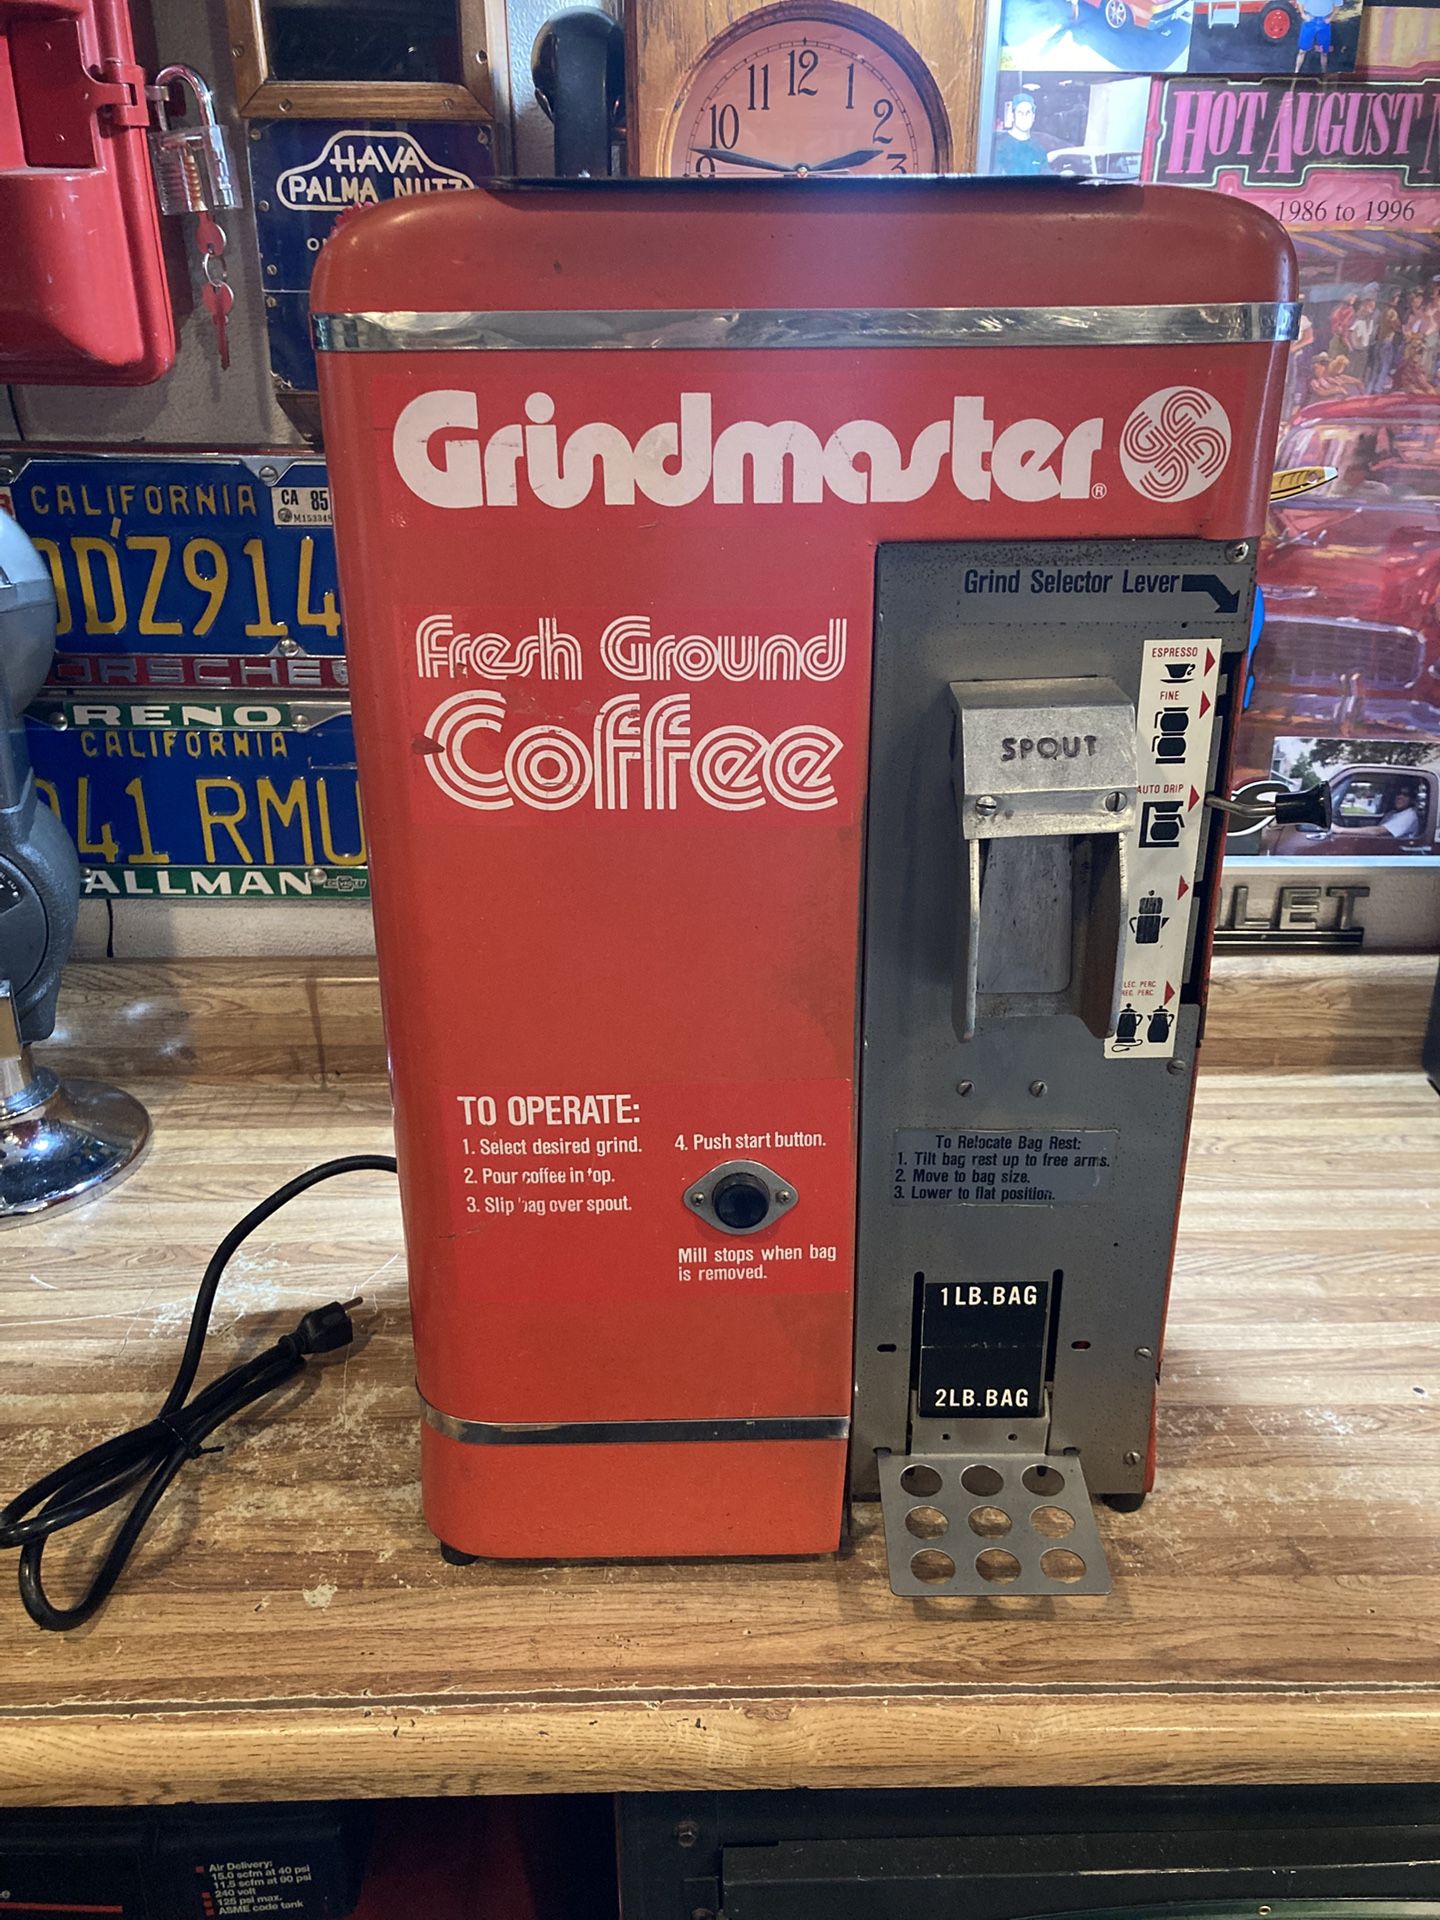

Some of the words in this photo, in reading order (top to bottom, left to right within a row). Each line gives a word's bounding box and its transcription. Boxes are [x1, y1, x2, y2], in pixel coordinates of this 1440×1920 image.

[788, 49, 818, 96] 12
[748, 64, 770, 110] 11
[845, 63, 854, 109] 1
[709, 104, 739, 149] 10
[872, 99, 894, 144] 2
[1165, 90, 1269, 173] HOT
[1257, 91, 1423, 173] AUGUST
[330, 145, 424, 173] HAVA
[288, 176, 379, 203] PALMA
[1278, 200, 1327, 222] 1986
[1335, 203, 1355, 221] to
[1365, 200, 1415, 222] 1996
[31, 485, 257, 516] CALIFORNIA
[281, 489, 299, 505] CA
[310, 490, 328, 511] 85
[964, 569, 1020, 593] Grind
[1030, 569, 1113, 593] Selector
[1122, 569, 1180, 593] Lever
[415, 614, 582, 680] Fresh
[600, 615, 847, 682] Ground
[1152, 647, 1198, 657] ESPRESSO
[56, 659, 321, 685] ORSCHE
[1160, 690, 1180, 701] FINE
[72, 706, 282, 726] RENO
[80, 731, 288, 758] CALIFORNIA
[423, 689, 844, 811] Coffee
[1000, 735, 1097, 762] SPOUT
[1137, 784, 1160, 794] AUTO
[1163, 784, 1184, 794] DRIP
[196, 776, 367, 865] RMU
[84, 870, 313, 896] ALLMAN
[1217, 885, 1370, 930] LET
[457, 1095, 497, 1126] TO
[507, 1094, 640, 1126] OPERATE:
[463, 1139, 475, 1155] 1.
[480, 1138, 527, 1155] Select
[533, 1137, 590, 1155] desired
[596, 1136, 642, 1157] grind.
[674, 1134, 688, 1151] 4.
[693, 1133, 732, 1150] Push
[736, 1133, 771, 1149] start
[775, 1132, 826, 1148] button.
[936, 1135, 951, 1149] To
[958, 1135, 1012, 1149] Relocate
[1018, 1136, 1043, 1152] Bag
[1050, 1136, 1081, 1150] Rest:
[898, 1152, 907, 1166] 1.
[915, 1152, 937, 1166] Tilt
[942, 1152, 966, 1168] bag
[972, 1153, 997, 1167] rest
[1003, 1155, 1019, 1168] up
[1025, 1153, 1037, 1167] to
[1043, 1153, 1068, 1167] free
[1074, 1155, 1110, 1167] arms.
[464, 1168, 478, 1184] 2.
[482, 1168, 518, 1184] Pour
[522, 1168, 566, 1184] coffee
[570, 1167, 584, 1183] in
[895, 1169, 906, 1182] 2.
[913, 1169, 949, 1183] Move
[955, 1170, 966, 1183] to
[972, 1170, 996, 1186] bag
[1001, 1171, 1030, 1183] size.
[894, 1186, 904, 1199] 3.
[911, 1186, 952, 1199] Lower
[958, 1186, 969, 1199] to
[975, 1186, 996, 1199] flat
[1001, 1186, 1055, 1202] position.
[466, 1197, 480, 1213] 3.
[485, 1197, 514, 1216] Slip
[550, 1199, 583, 1213] over
[587, 1196, 632, 1215] spout.
[678, 1247, 707, 1263] Mill
[714, 1247, 754, 1264] stops
[761, 1245, 802, 1260] when
[810, 1244, 837, 1261] bag
[678, 1266, 691, 1281] is
[699, 1264, 767, 1281] removed.
[209, 1863, 225, 1873] Air
[227, 1861, 273, 1871] Delivery:
[212, 1872, 234, 1881] 15.0
[237, 1869, 263, 1879] scfm
[278, 1866, 292, 1874] 40
[294, 1864, 310, 1874] psi
[214, 1880, 236, 1889] 11.5
[239, 1877, 265, 1887] scfm
[267, 1876, 278, 1884] at
[296, 1873, 312, 1884] psi
[215, 1889, 235, 1898] 240
[237, 1887, 256, 1896] volt
[217, 1898, 237, 1906] 125
[240, 1896, 255, 1905] psi
[257, 1894, 282, 1902] max.
[219, 1905, 251, 1915] ASME
[252, 1902, 278, 1912] code
[281, 1900, 304, 1909] tank
